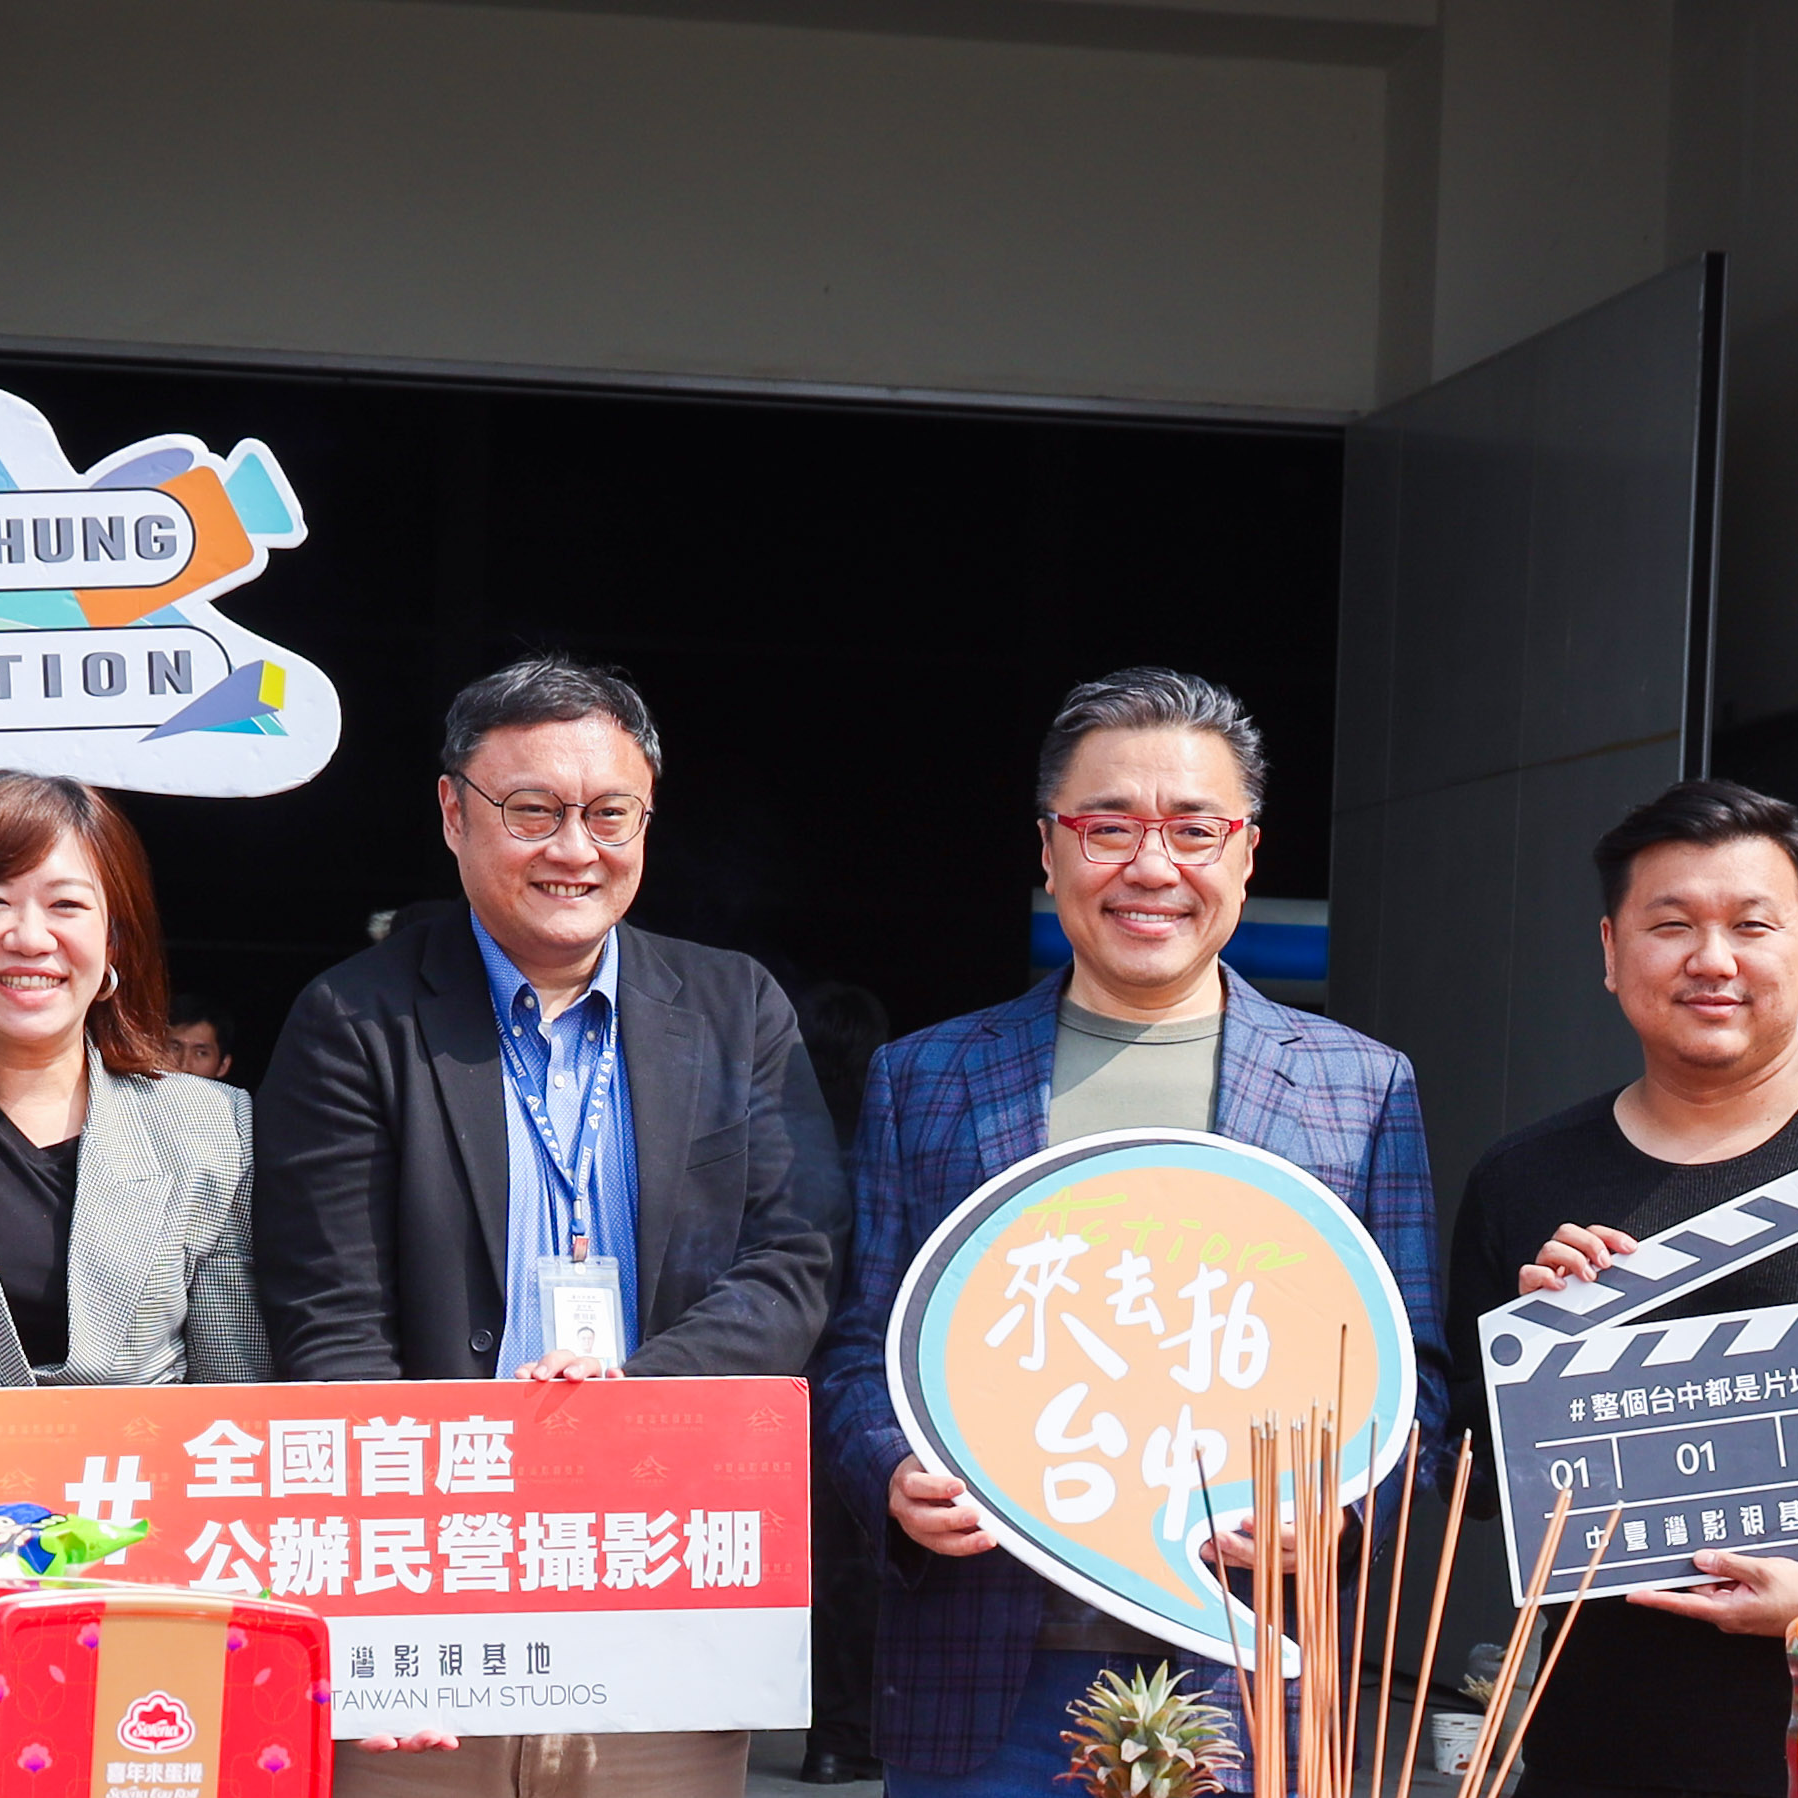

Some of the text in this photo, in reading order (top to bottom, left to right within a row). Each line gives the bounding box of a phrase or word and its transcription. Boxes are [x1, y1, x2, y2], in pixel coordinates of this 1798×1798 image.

[984, 1230, 1270, 1392] 來去拍
[183, 1416, 515, 1498] 全國首座
[1034, 1383, 1228, 1541] 台中
[1550, 1457, 1591, 1490] 01
[1676, 1441, 1717, 1474] 01
[185, 1509, 762, 1598] 公辦民營攝影棚
[332, 1683, 608, 1712] TAIWAN FILM STUDIOS
